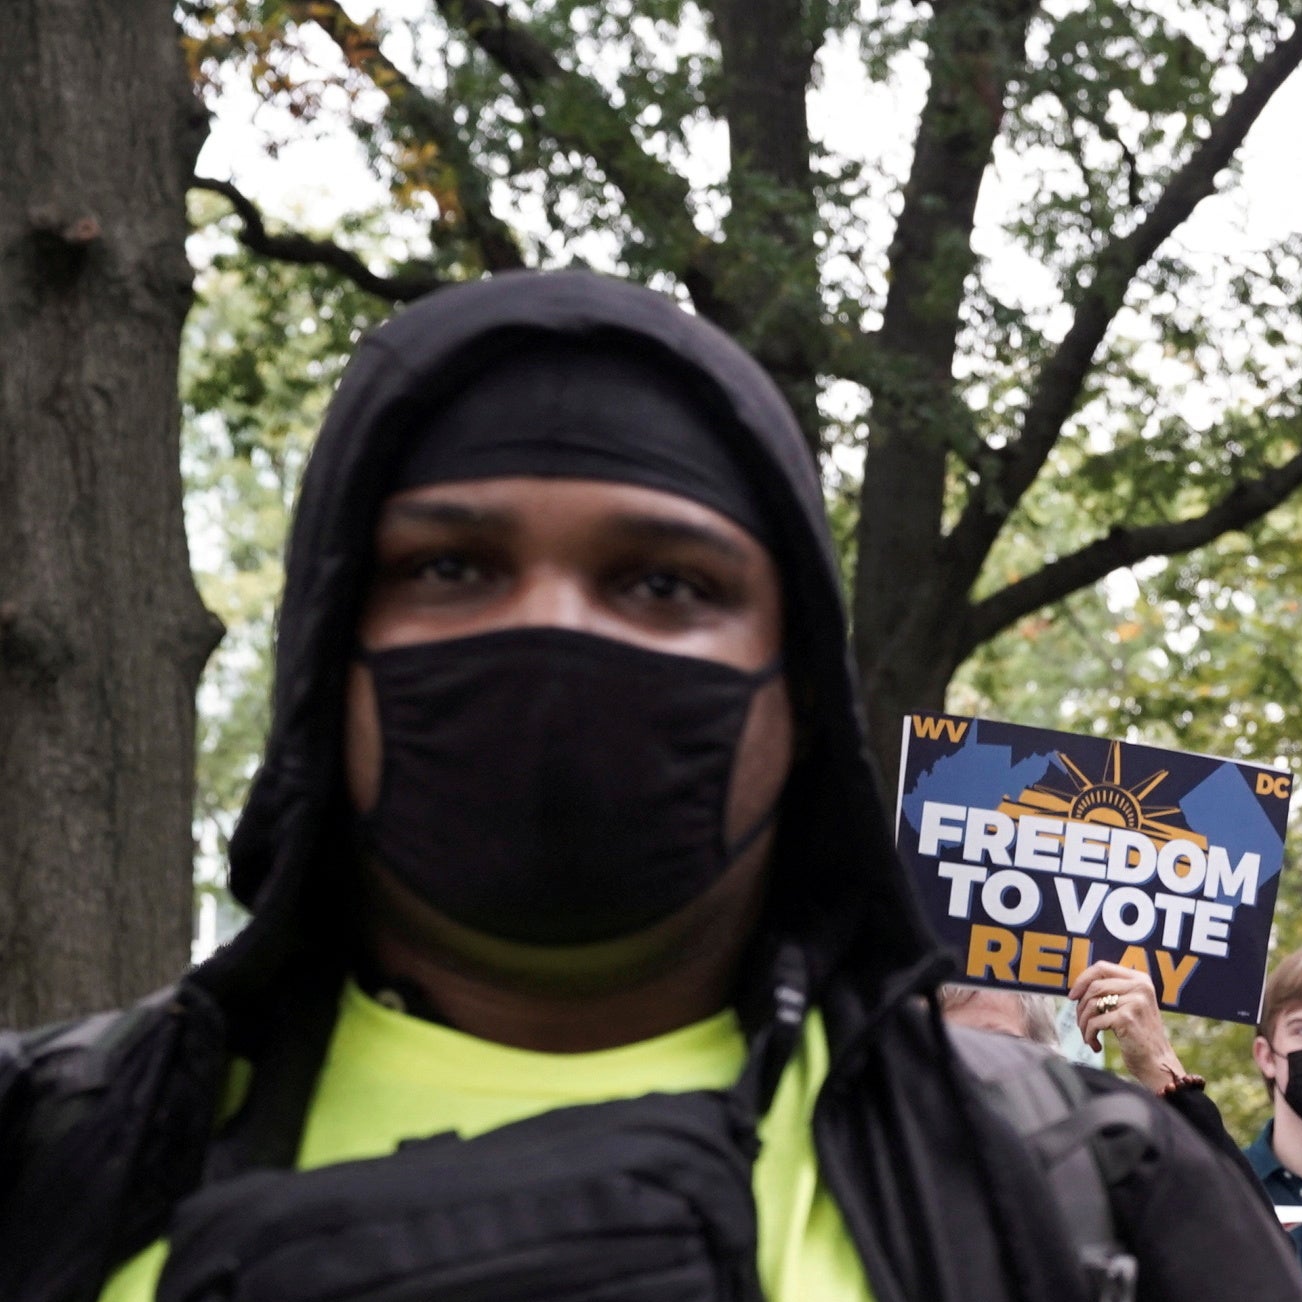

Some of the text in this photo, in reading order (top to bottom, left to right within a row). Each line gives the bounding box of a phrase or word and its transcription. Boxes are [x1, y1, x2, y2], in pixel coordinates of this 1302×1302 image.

[912, 715, 968, 743] WV
[1255, 772, 1290, 800] DC
[918, 801, 1261, 906] FREEDOM
[938, 862, 1234, 958] TO VOTE
